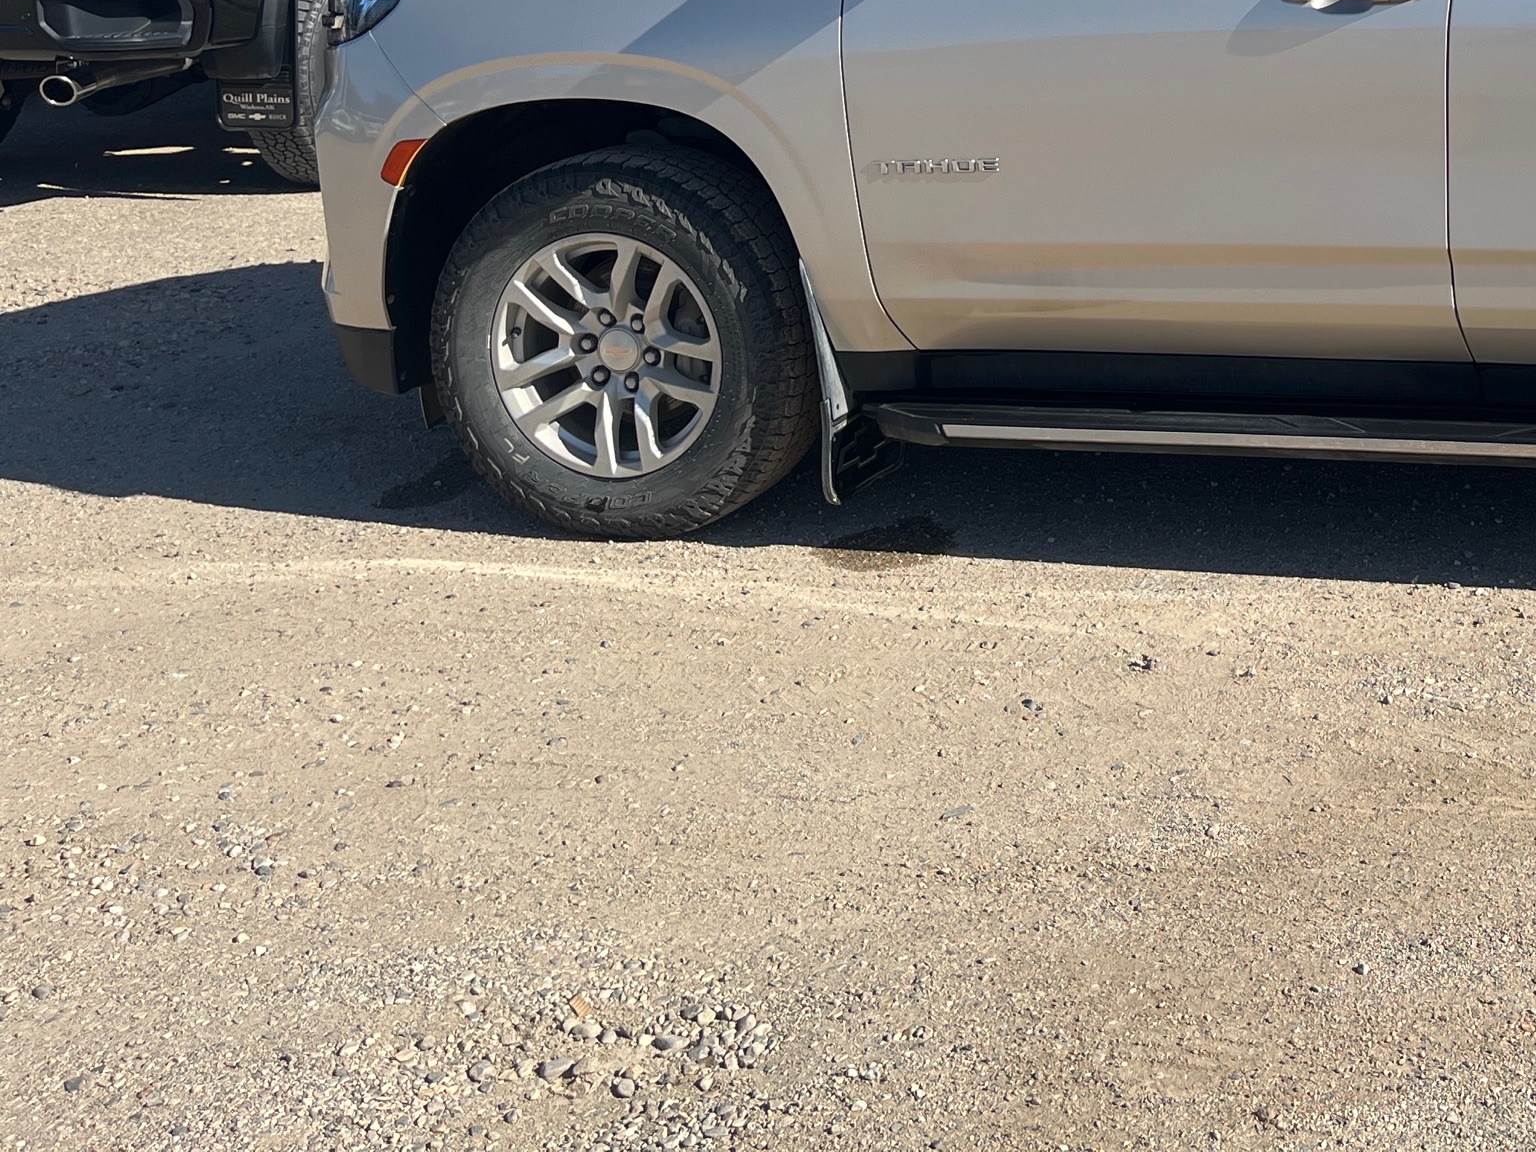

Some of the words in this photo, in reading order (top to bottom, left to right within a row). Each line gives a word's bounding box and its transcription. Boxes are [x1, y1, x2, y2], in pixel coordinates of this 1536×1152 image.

[222, 92, 253, 105] Quill
[256, 92, 291, 104] Plains
[871, 157, 1000, 175] TAHOE
[549, 204, 678, 243] COOPER
